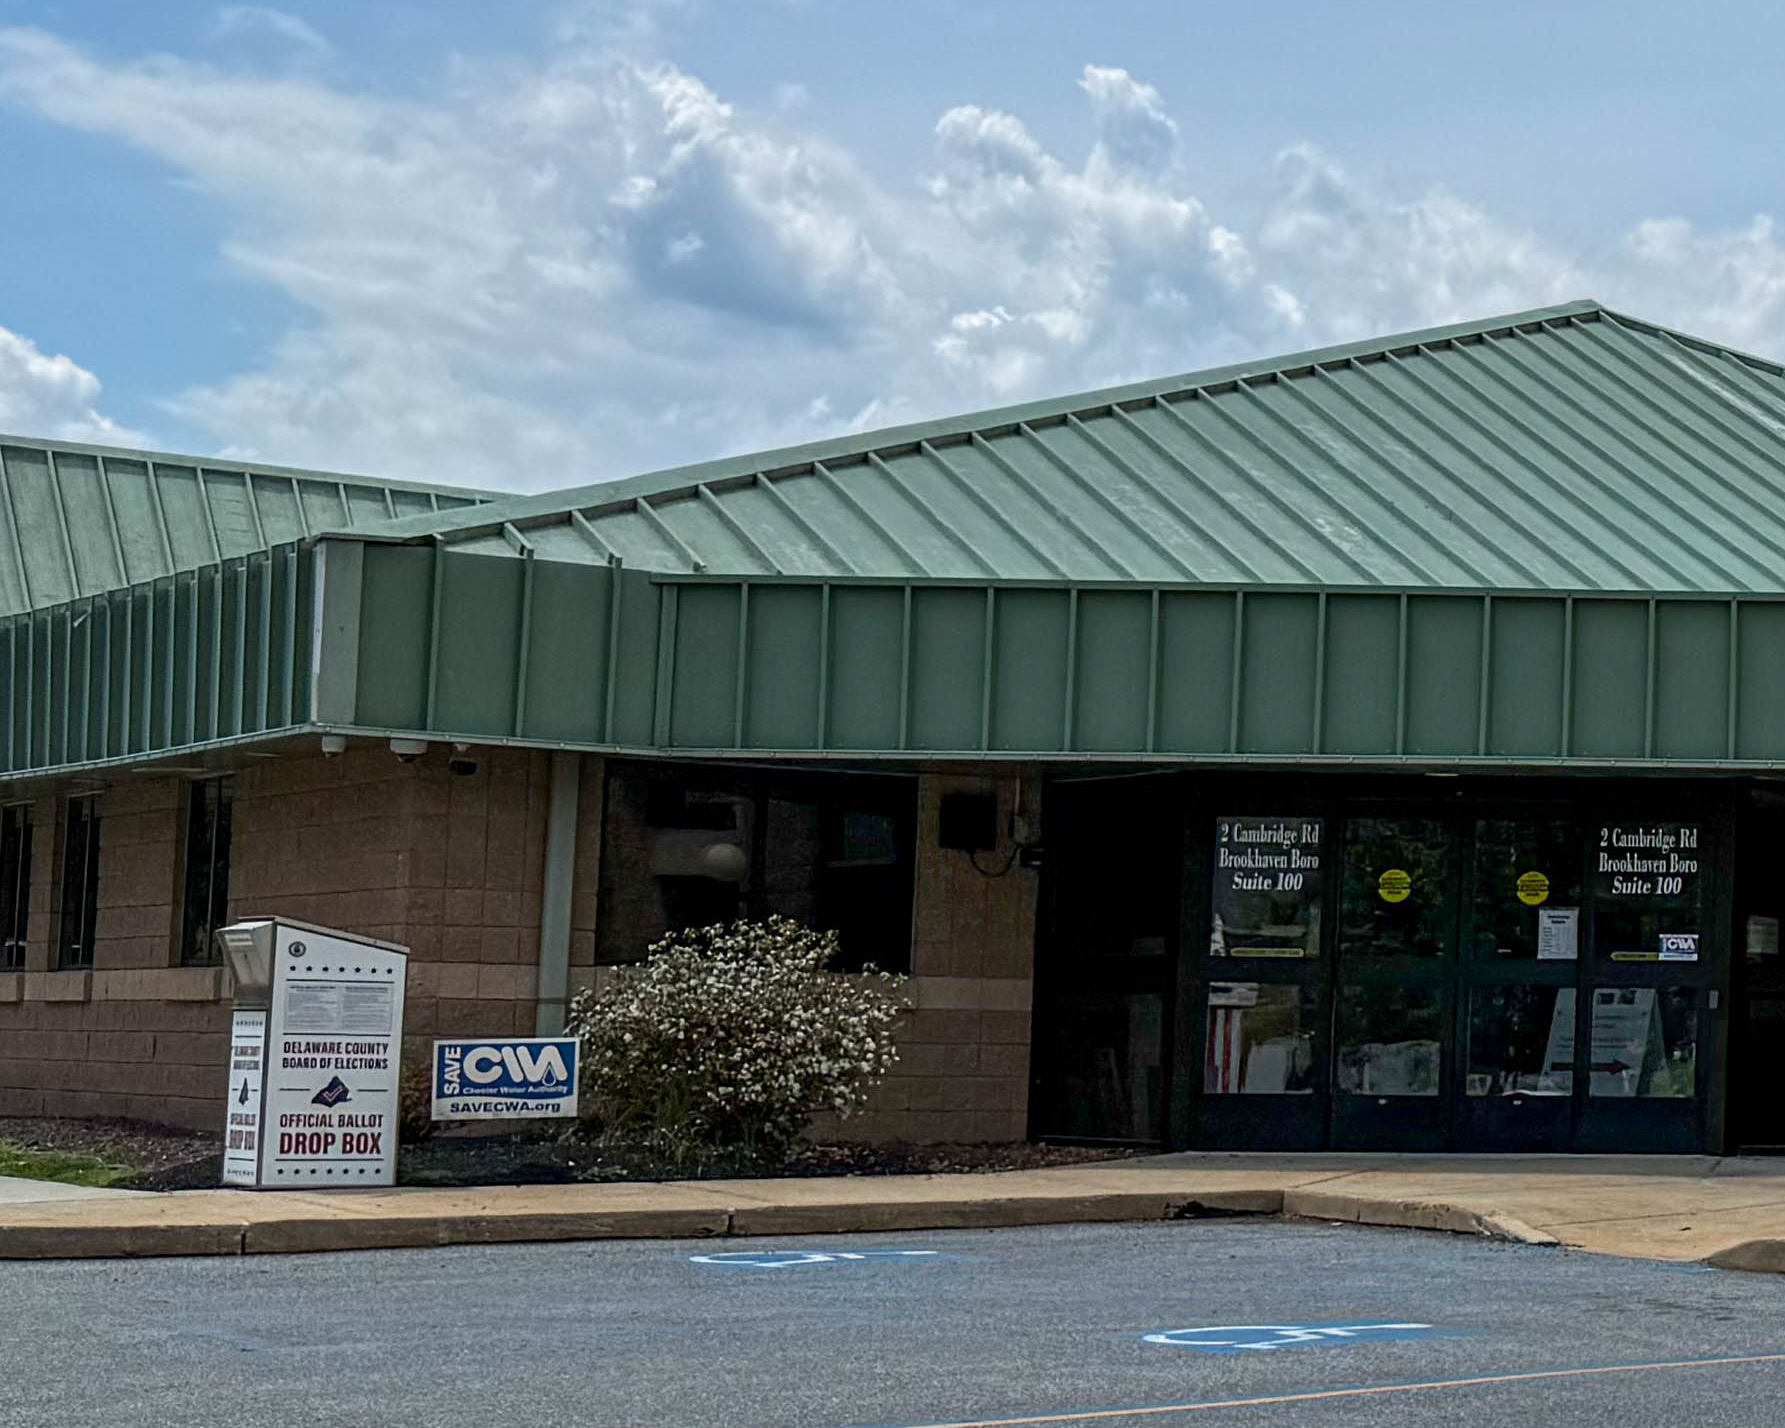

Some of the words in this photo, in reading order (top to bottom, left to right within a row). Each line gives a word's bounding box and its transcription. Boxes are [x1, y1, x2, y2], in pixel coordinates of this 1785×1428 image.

[1221, 823, 1229, 842] 2
[1234, 823, 1298, 850] Cambridge
[1301, 824, 1319, 843] Rd
[1600, 827, 1608, 847] 2
[1612, 827, 1676, 854] Cambridge
[1680, 828, 1697, 848] Rd
[1219, 847, 1287, 869] Brookhaven
[1291, 848, 1319, 869] Boro
[1599, 852, 1666, 873] Brookhaven
[1670, 853, 1697, 873] Boro
[1232, 871, 1272, 890] Suite
[1275, 872, 1303, 891] 100
[1612, 876, 1651, 894] Suite
[1654, 876, 1682, 894] 100
[283, 1041, 343, 1054] DELAWARE
[345, 1042, 389, 1055] COUNTY
[282, 1057, 317, 1069] BOARD
[320, 1057, 332, 1069] OF
[334, 1057, 388, 1070] ELECTIONS
[444, 1047, 460, 1095] SAVE
[463, 1045, 568, 1084] CWA
[450, 1101, 561, 1114] SAVECWA.org
[280, 1114, 334, 1128] OFFICIAL
[337, 1114, 384, 1128] BALLOT
[280, 1132, 336, 1155] DROP
[342, 1132, 382, 1155] BOX
